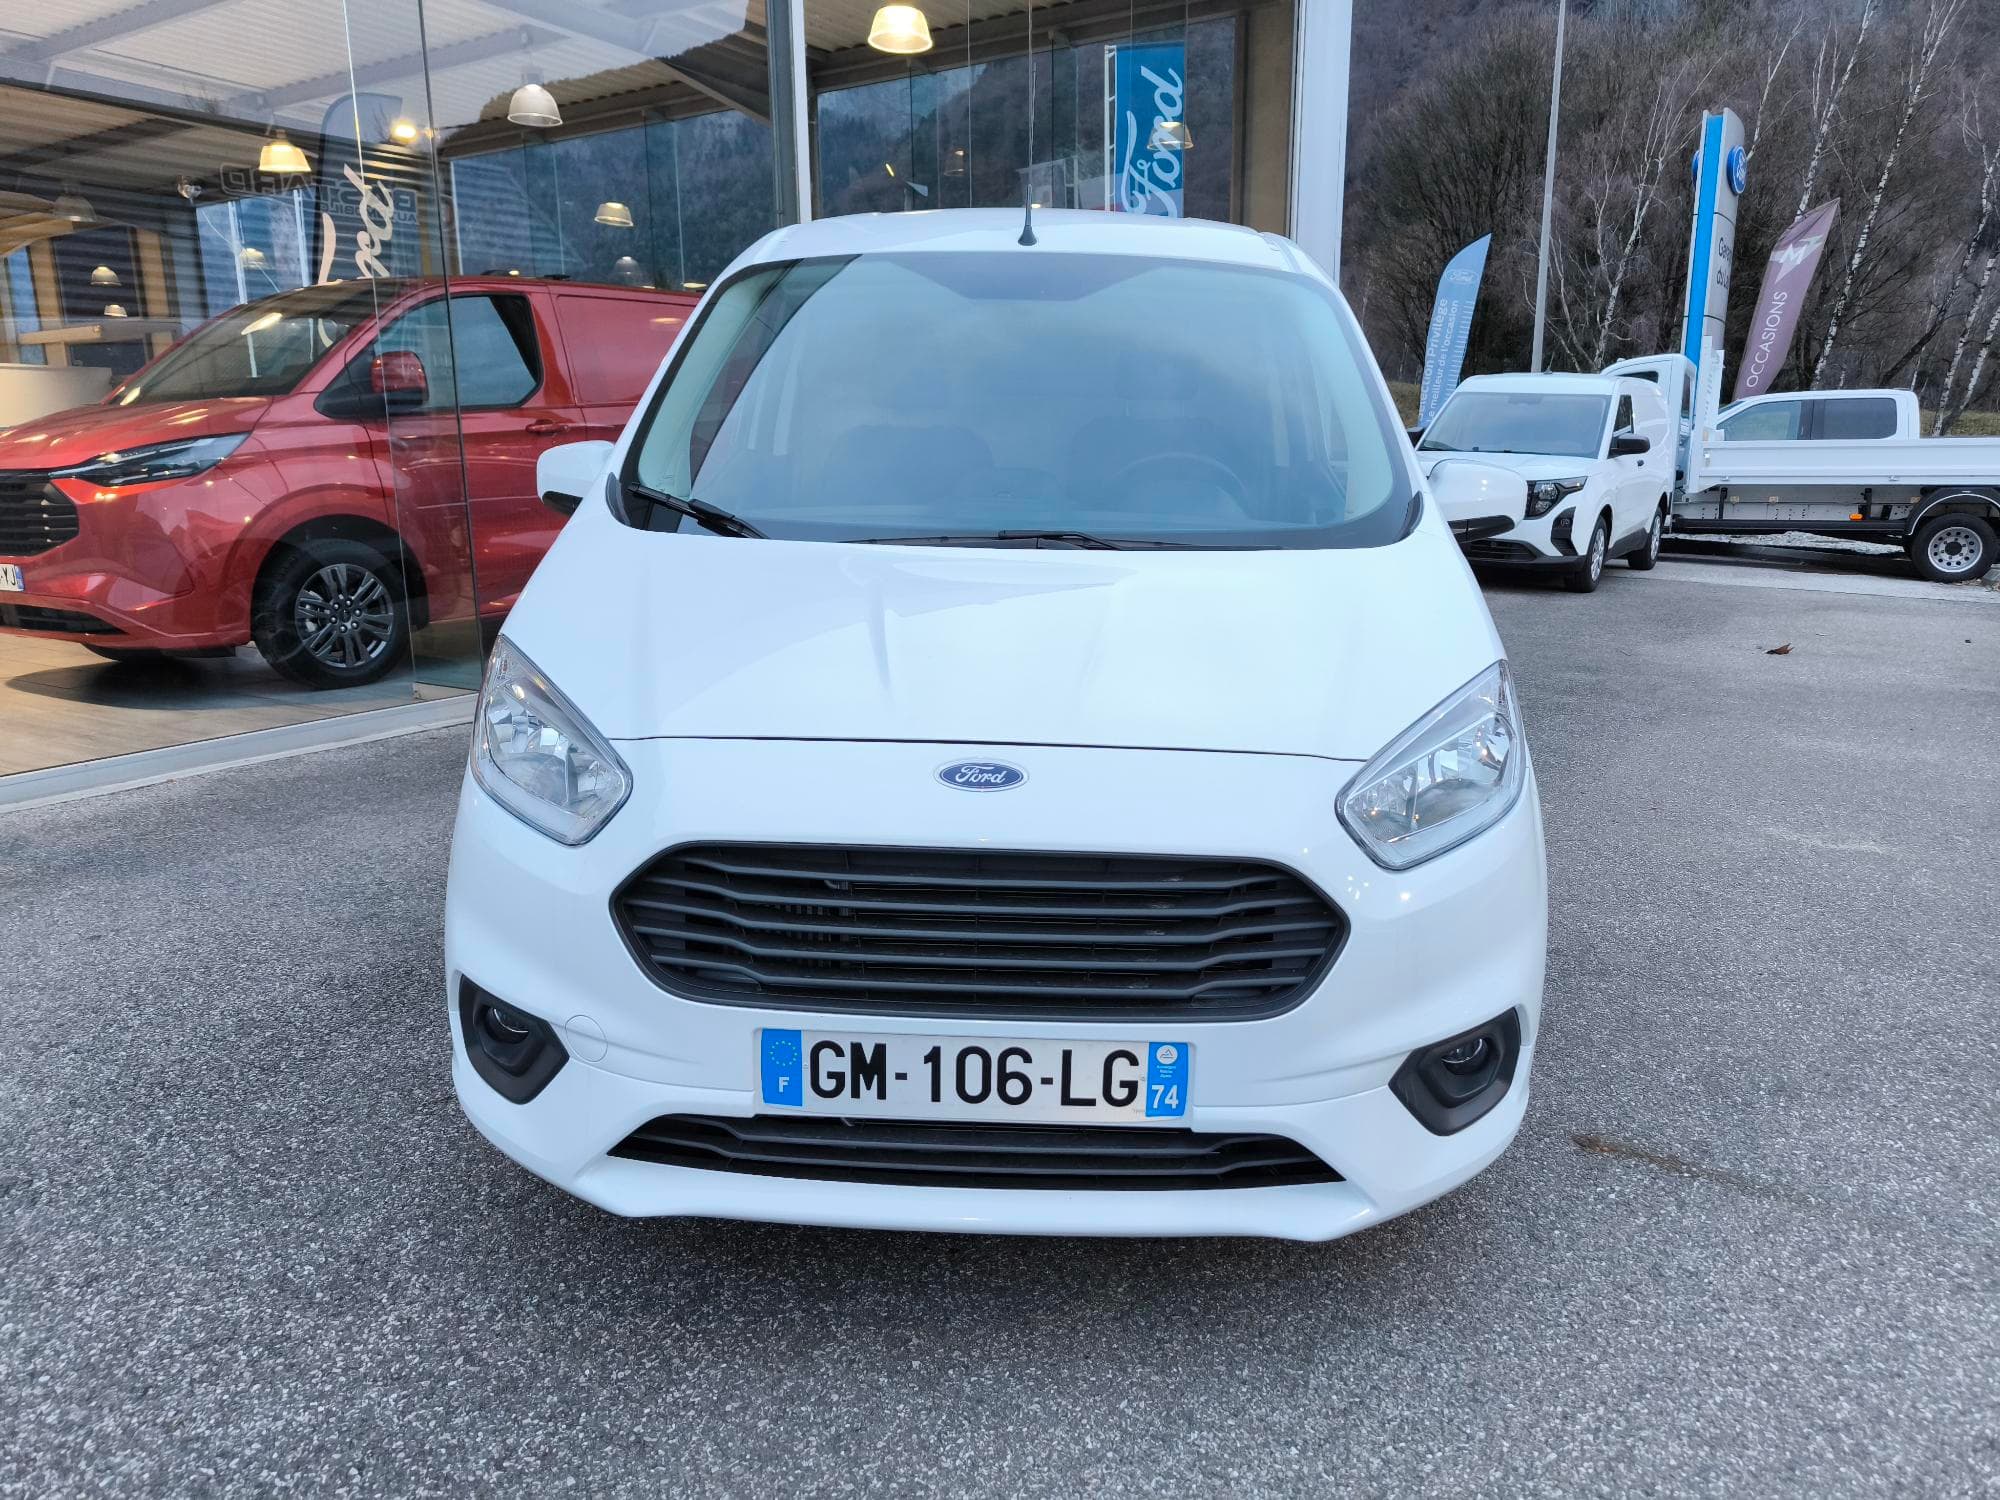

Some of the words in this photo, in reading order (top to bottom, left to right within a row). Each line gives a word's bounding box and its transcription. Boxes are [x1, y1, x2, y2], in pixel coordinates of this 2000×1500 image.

[1121, 65, 1183, 218] Ford
[1440, 300, 1459, 352] l'occasion
[1746, 291, 1788, 388] OCCASIONS
[1438, 352, 1447, 367] de
[1431, 367, 1444, 409] meilleur
[955, 765, 1008, 784] Ford
[778, 1076, 790, 1093] F
[809, 1040, 1139, 1107] GM-106-LG
[1151, 1084, 1179, 1110] 74
